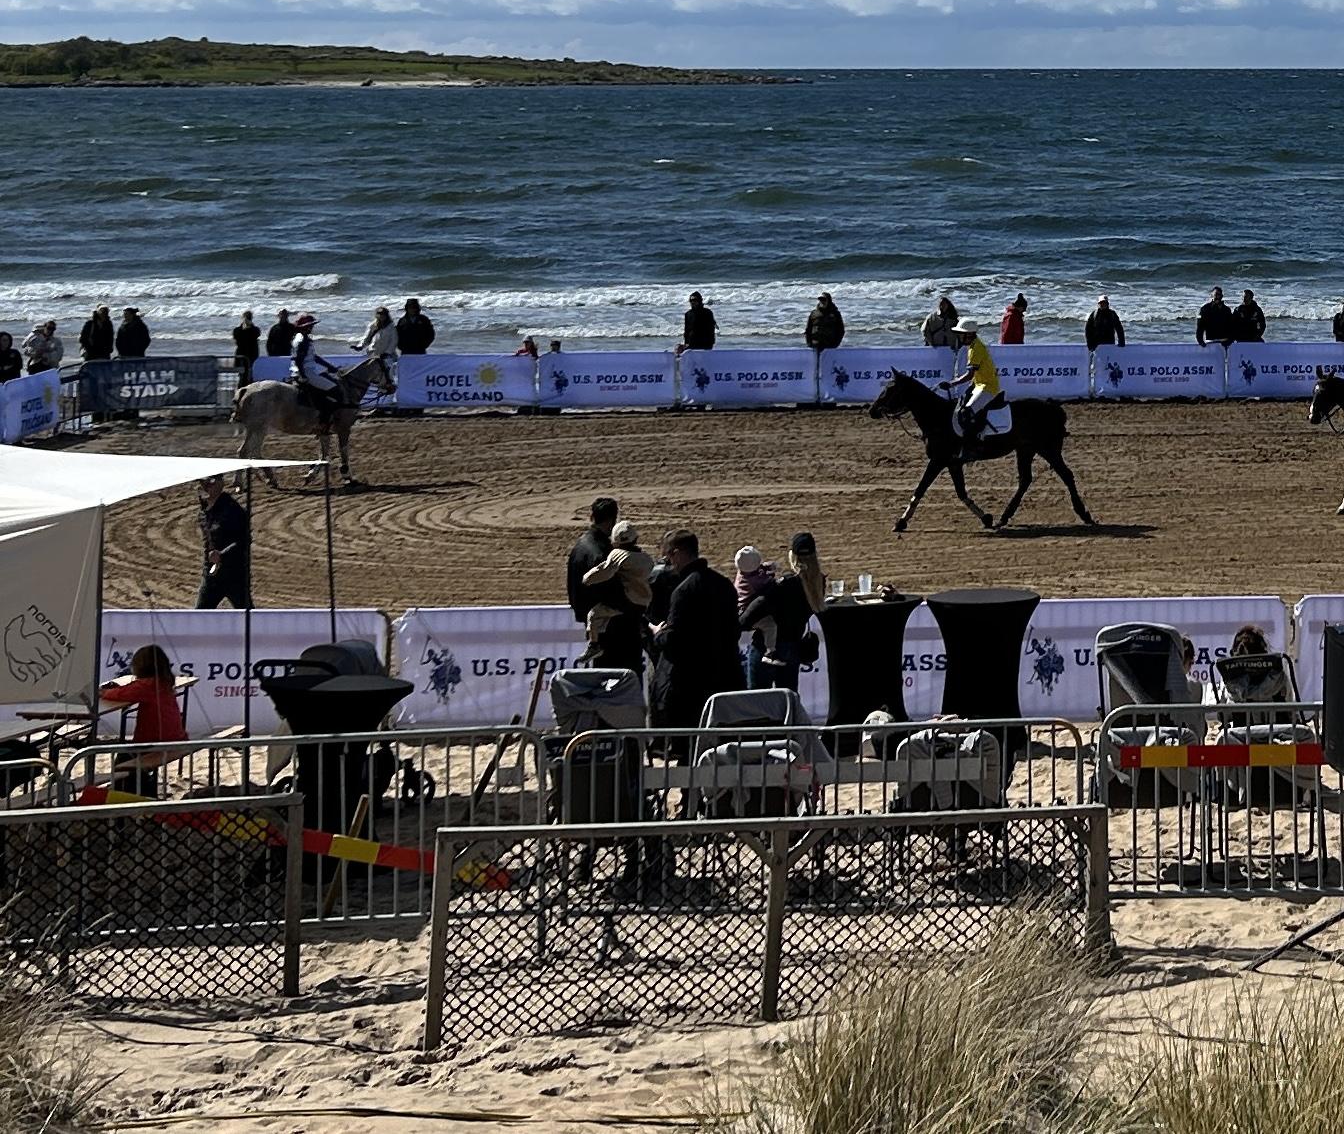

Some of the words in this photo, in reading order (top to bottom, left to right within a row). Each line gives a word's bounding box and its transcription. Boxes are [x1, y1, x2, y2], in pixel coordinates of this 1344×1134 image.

[1014, 368, 1043, 377] POLO
[1150, 366, 1179, 376] POLO
[1284, 365, 1313, 374] POLO
[124, 370, 176, 384] HALM
[425, 375, 473, 387] HOTEL
[597, 374, 627, 384] POLO
[738, 372, 767, 381] POLO
[120, 385, 168, 398] STAD
[427, 389, 504, 403] TYLÖSAND
[21, 397, 44, 413] HOTEL
[472, 659, 516, 676] U.S.
[902, 654, 948, 671] ASS
